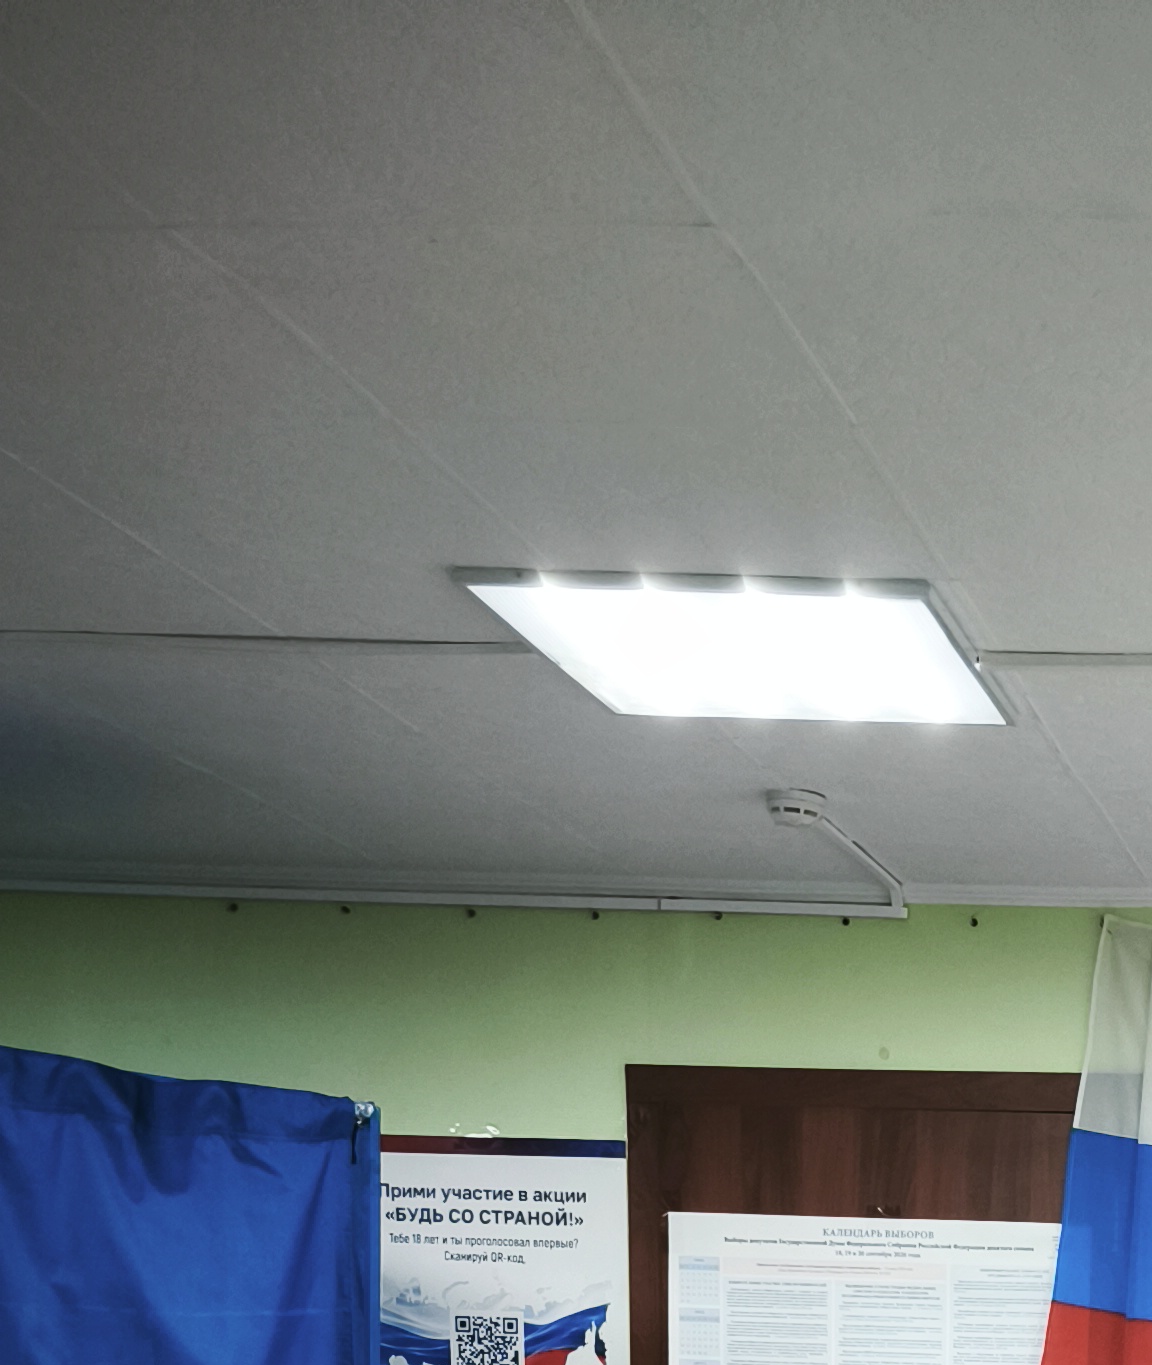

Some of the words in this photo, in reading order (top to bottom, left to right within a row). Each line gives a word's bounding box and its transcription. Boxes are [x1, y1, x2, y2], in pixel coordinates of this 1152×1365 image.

[380, 1182, 436, 1201] Прими
[441, 1187, 514, 1204] участие
[518, 1190, 528, 1201] в
[532, 1190, 587, 1205] акции
[385, 1206, 444, 1225] «БУДЬ
[448, 1208, 474, 1224] СО
[479, 1208, 584, 1227] СТРАНОЙ!»
[389, 1232, 410, 1244] Тебе
[412, 1233, 422, 1244] 18
[423, 1235, 439, 1245] лет
[442, 1236, 448, 1245] и
[450, 1236, 463, 1246] ты
[465, 1237, 531, 1248] проголосовал
[533, 1238, 579, 1249] впервые?
[823, 1228, 883, 1238] КАЛЕНДАРЬ
[885, 1229, 935, 1239] ВЫБОРОВ
[444, 1251, 488, 1264] Сканируй
